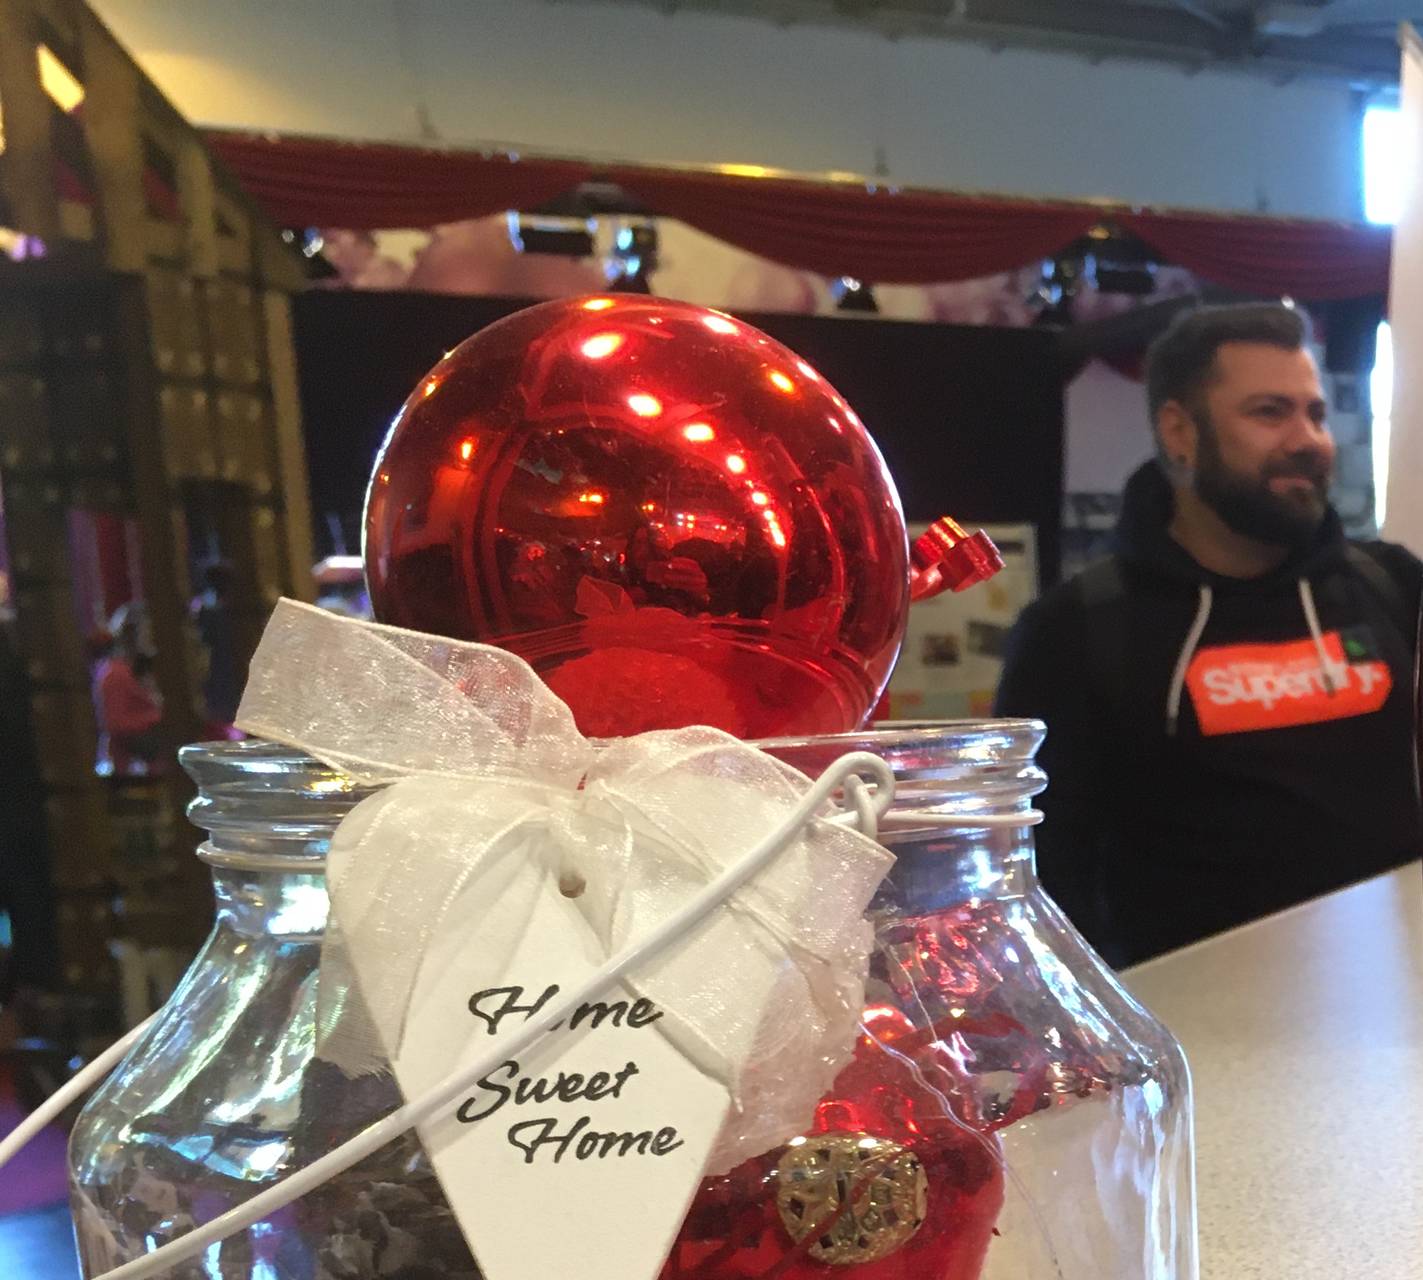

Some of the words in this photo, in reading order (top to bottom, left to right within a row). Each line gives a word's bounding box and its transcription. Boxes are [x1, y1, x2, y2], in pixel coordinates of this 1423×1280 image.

[468, 984, 664, 1035] Hme
[456, 1060, 639, 1123] Sweet
[507, 1115, 684, 1164] Home
